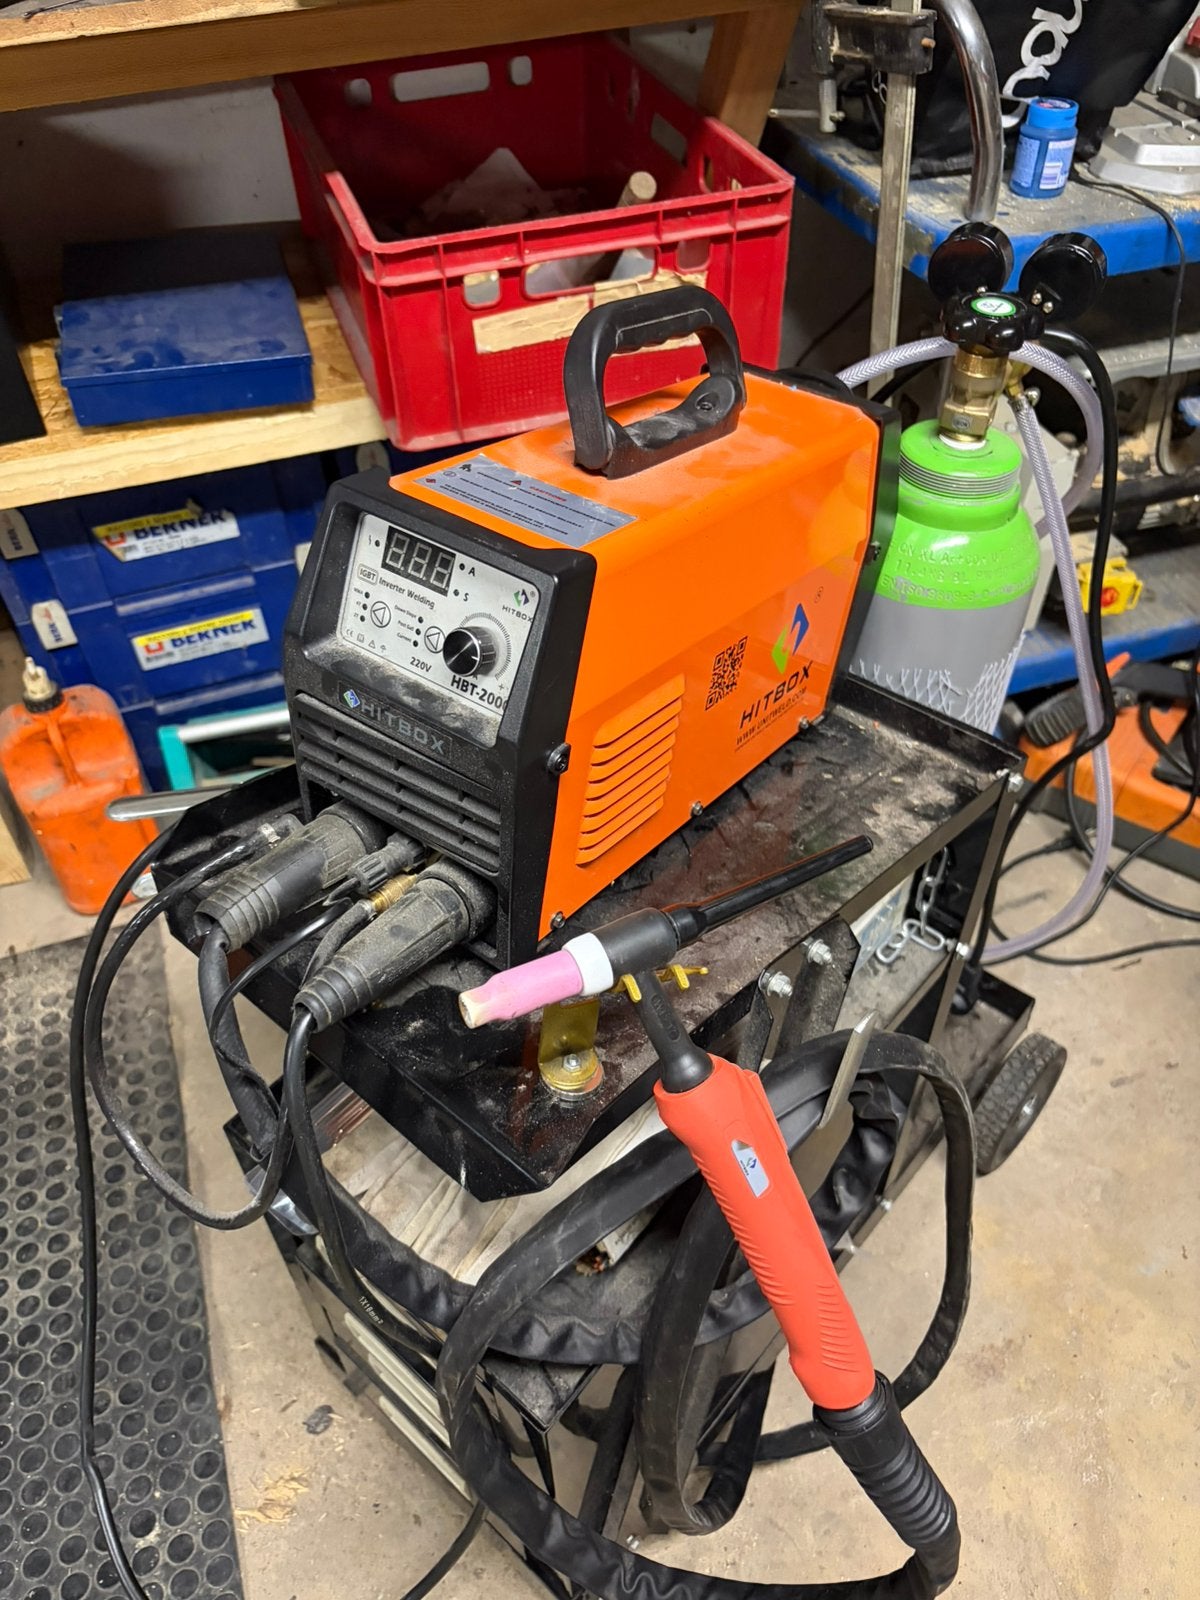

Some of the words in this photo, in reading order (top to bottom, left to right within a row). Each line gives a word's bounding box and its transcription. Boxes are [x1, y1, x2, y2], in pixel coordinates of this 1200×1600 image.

[467, 567, 476, 577] A
[358, 567, 377, 582] IGBT
[378, 577, 406, 595] Inverter
[407, 589, 436, 610] Welding
[462, 592, 470, 602] S
[501, 604, 534, 623] HITBOX
[410, 656, 432, 673] 220V
[740, 660, 814, 730] HITBOX
[360, 698, 445, 756] HITBOX
